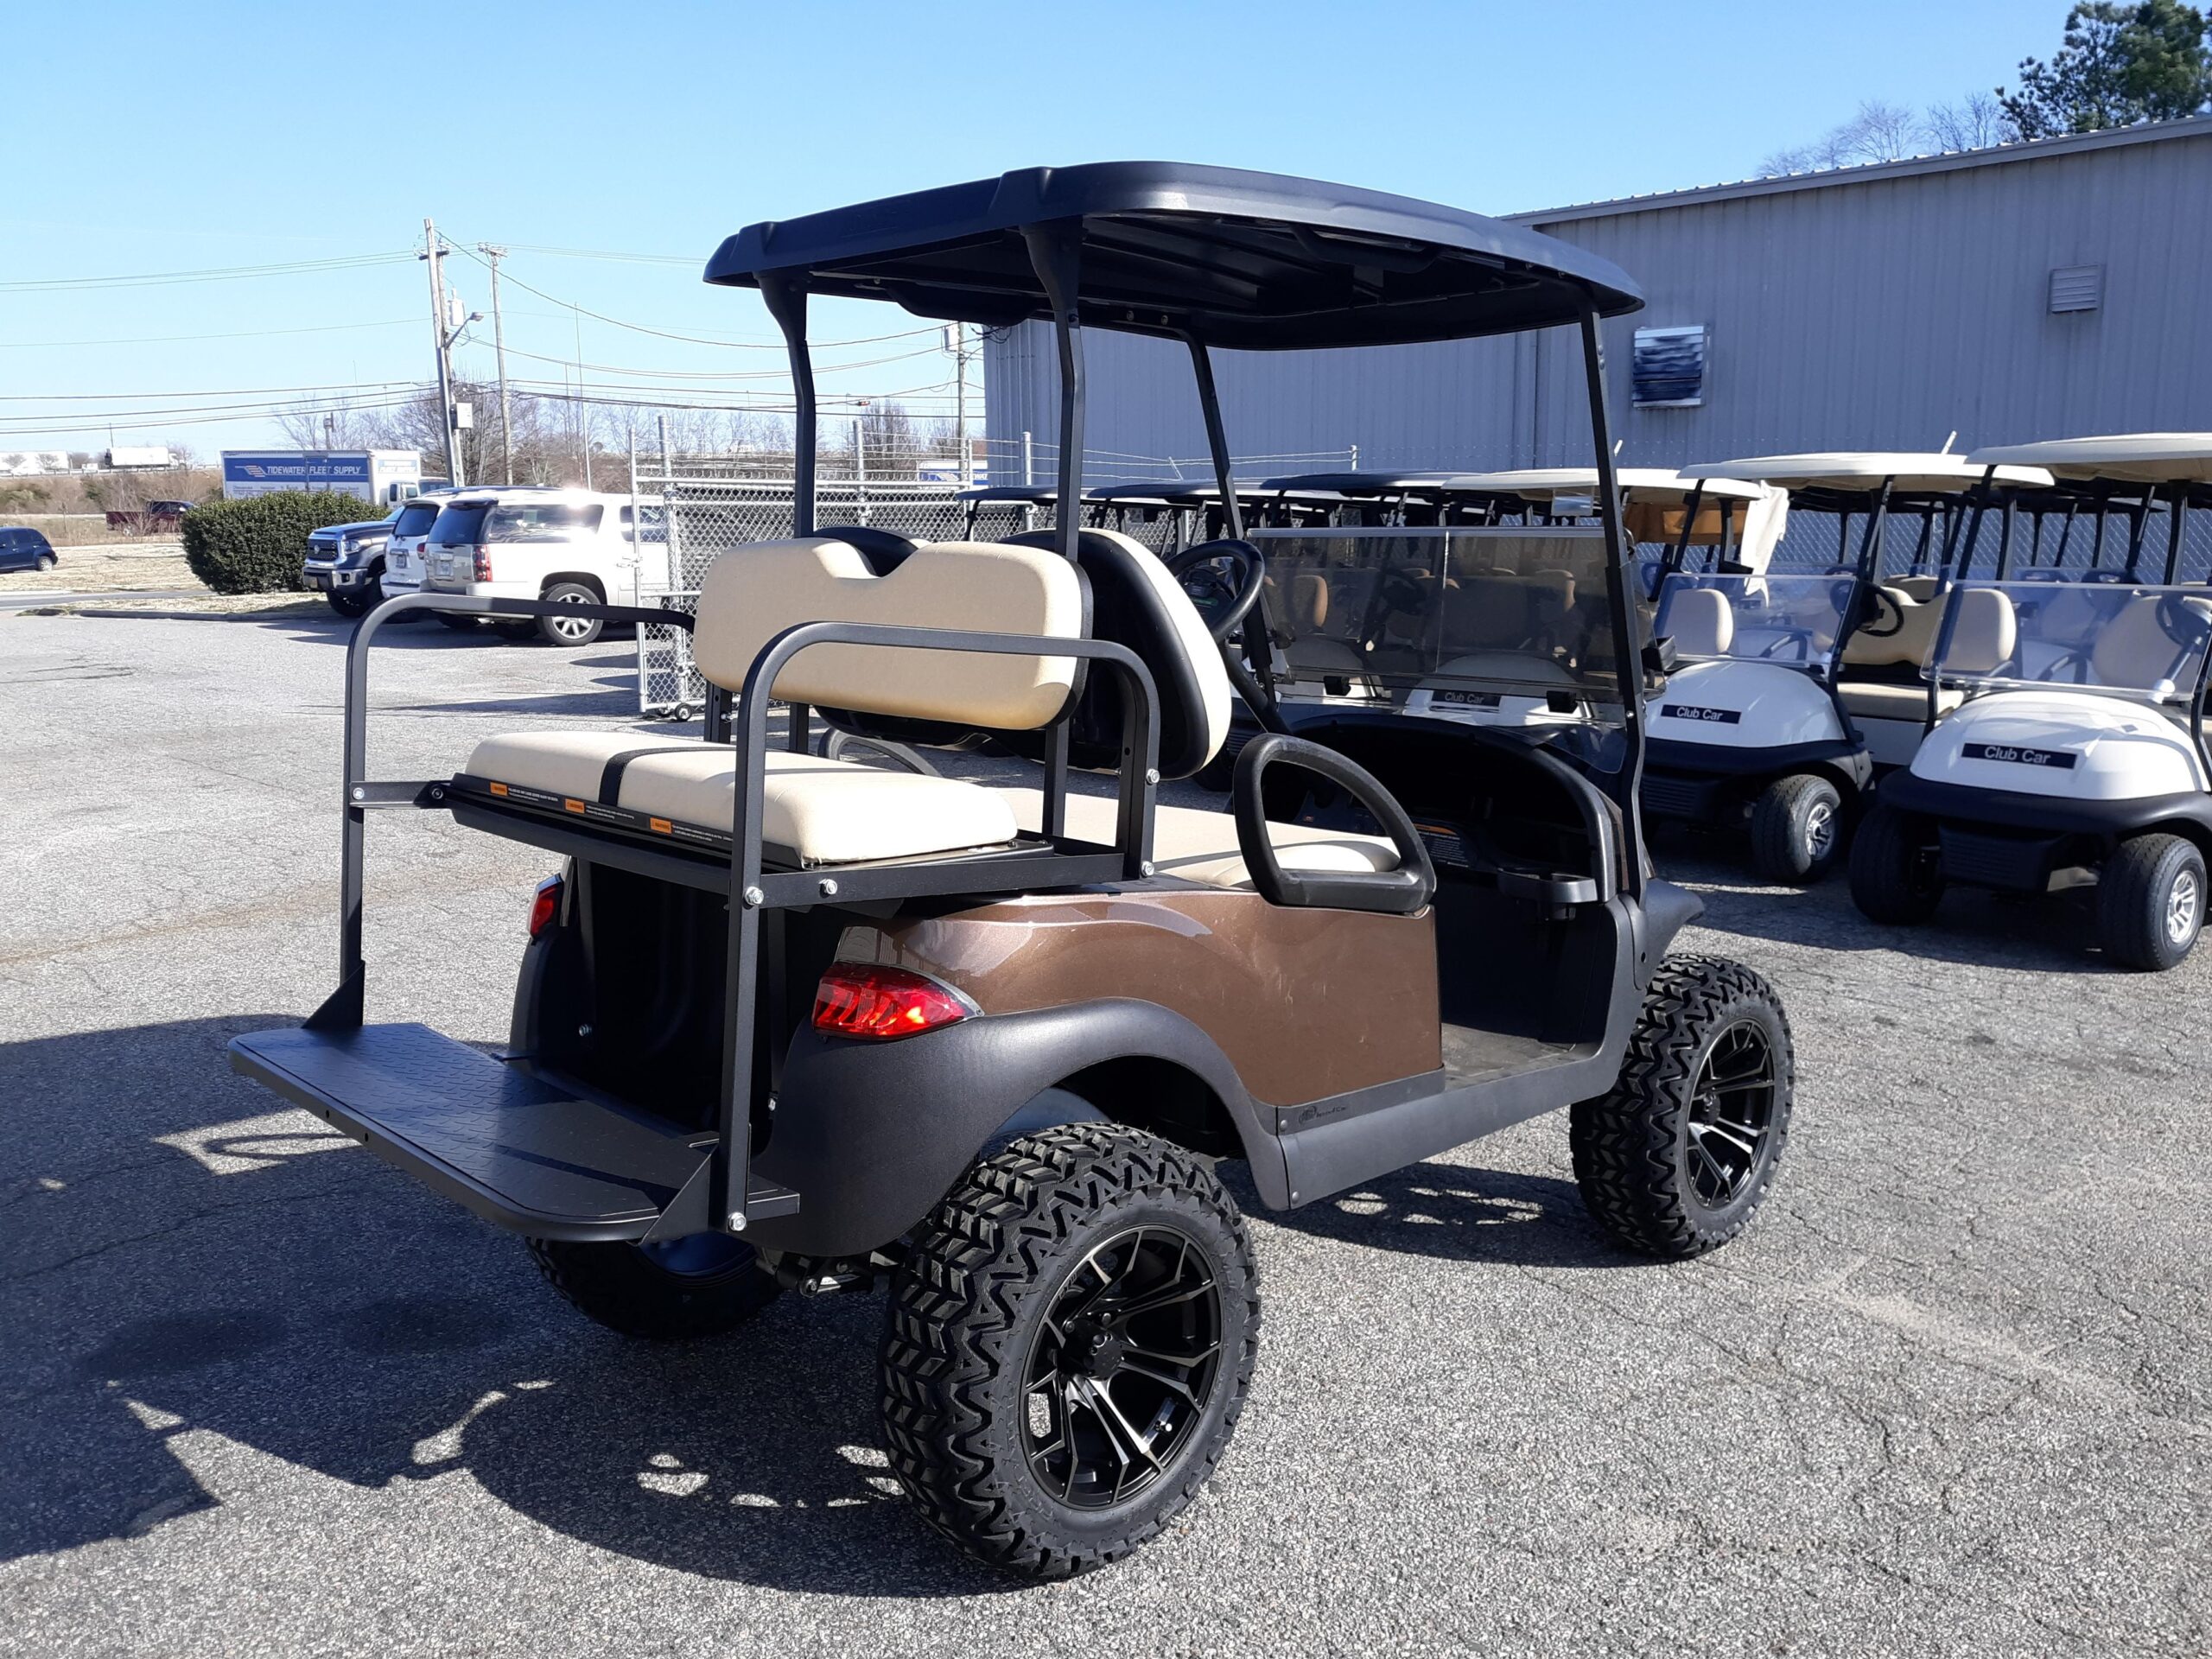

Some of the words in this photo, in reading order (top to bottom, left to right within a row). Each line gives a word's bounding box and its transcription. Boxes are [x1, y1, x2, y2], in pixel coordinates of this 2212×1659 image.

[267, 466, 306, 474] TIDEWATER
[308, 466, 331, 474] FLEET
[334, 466, 361, 474] SUPPLY
[1444, 691, 1465, 702] Club
[1466, 693, 1485, 704] Car
[1676, 706, 1700, 719] Club
[1702, 709, 1725, 721] Car
[1984, 746, 2018, 761] Club
[2021, 749, 2051, 765] Car
